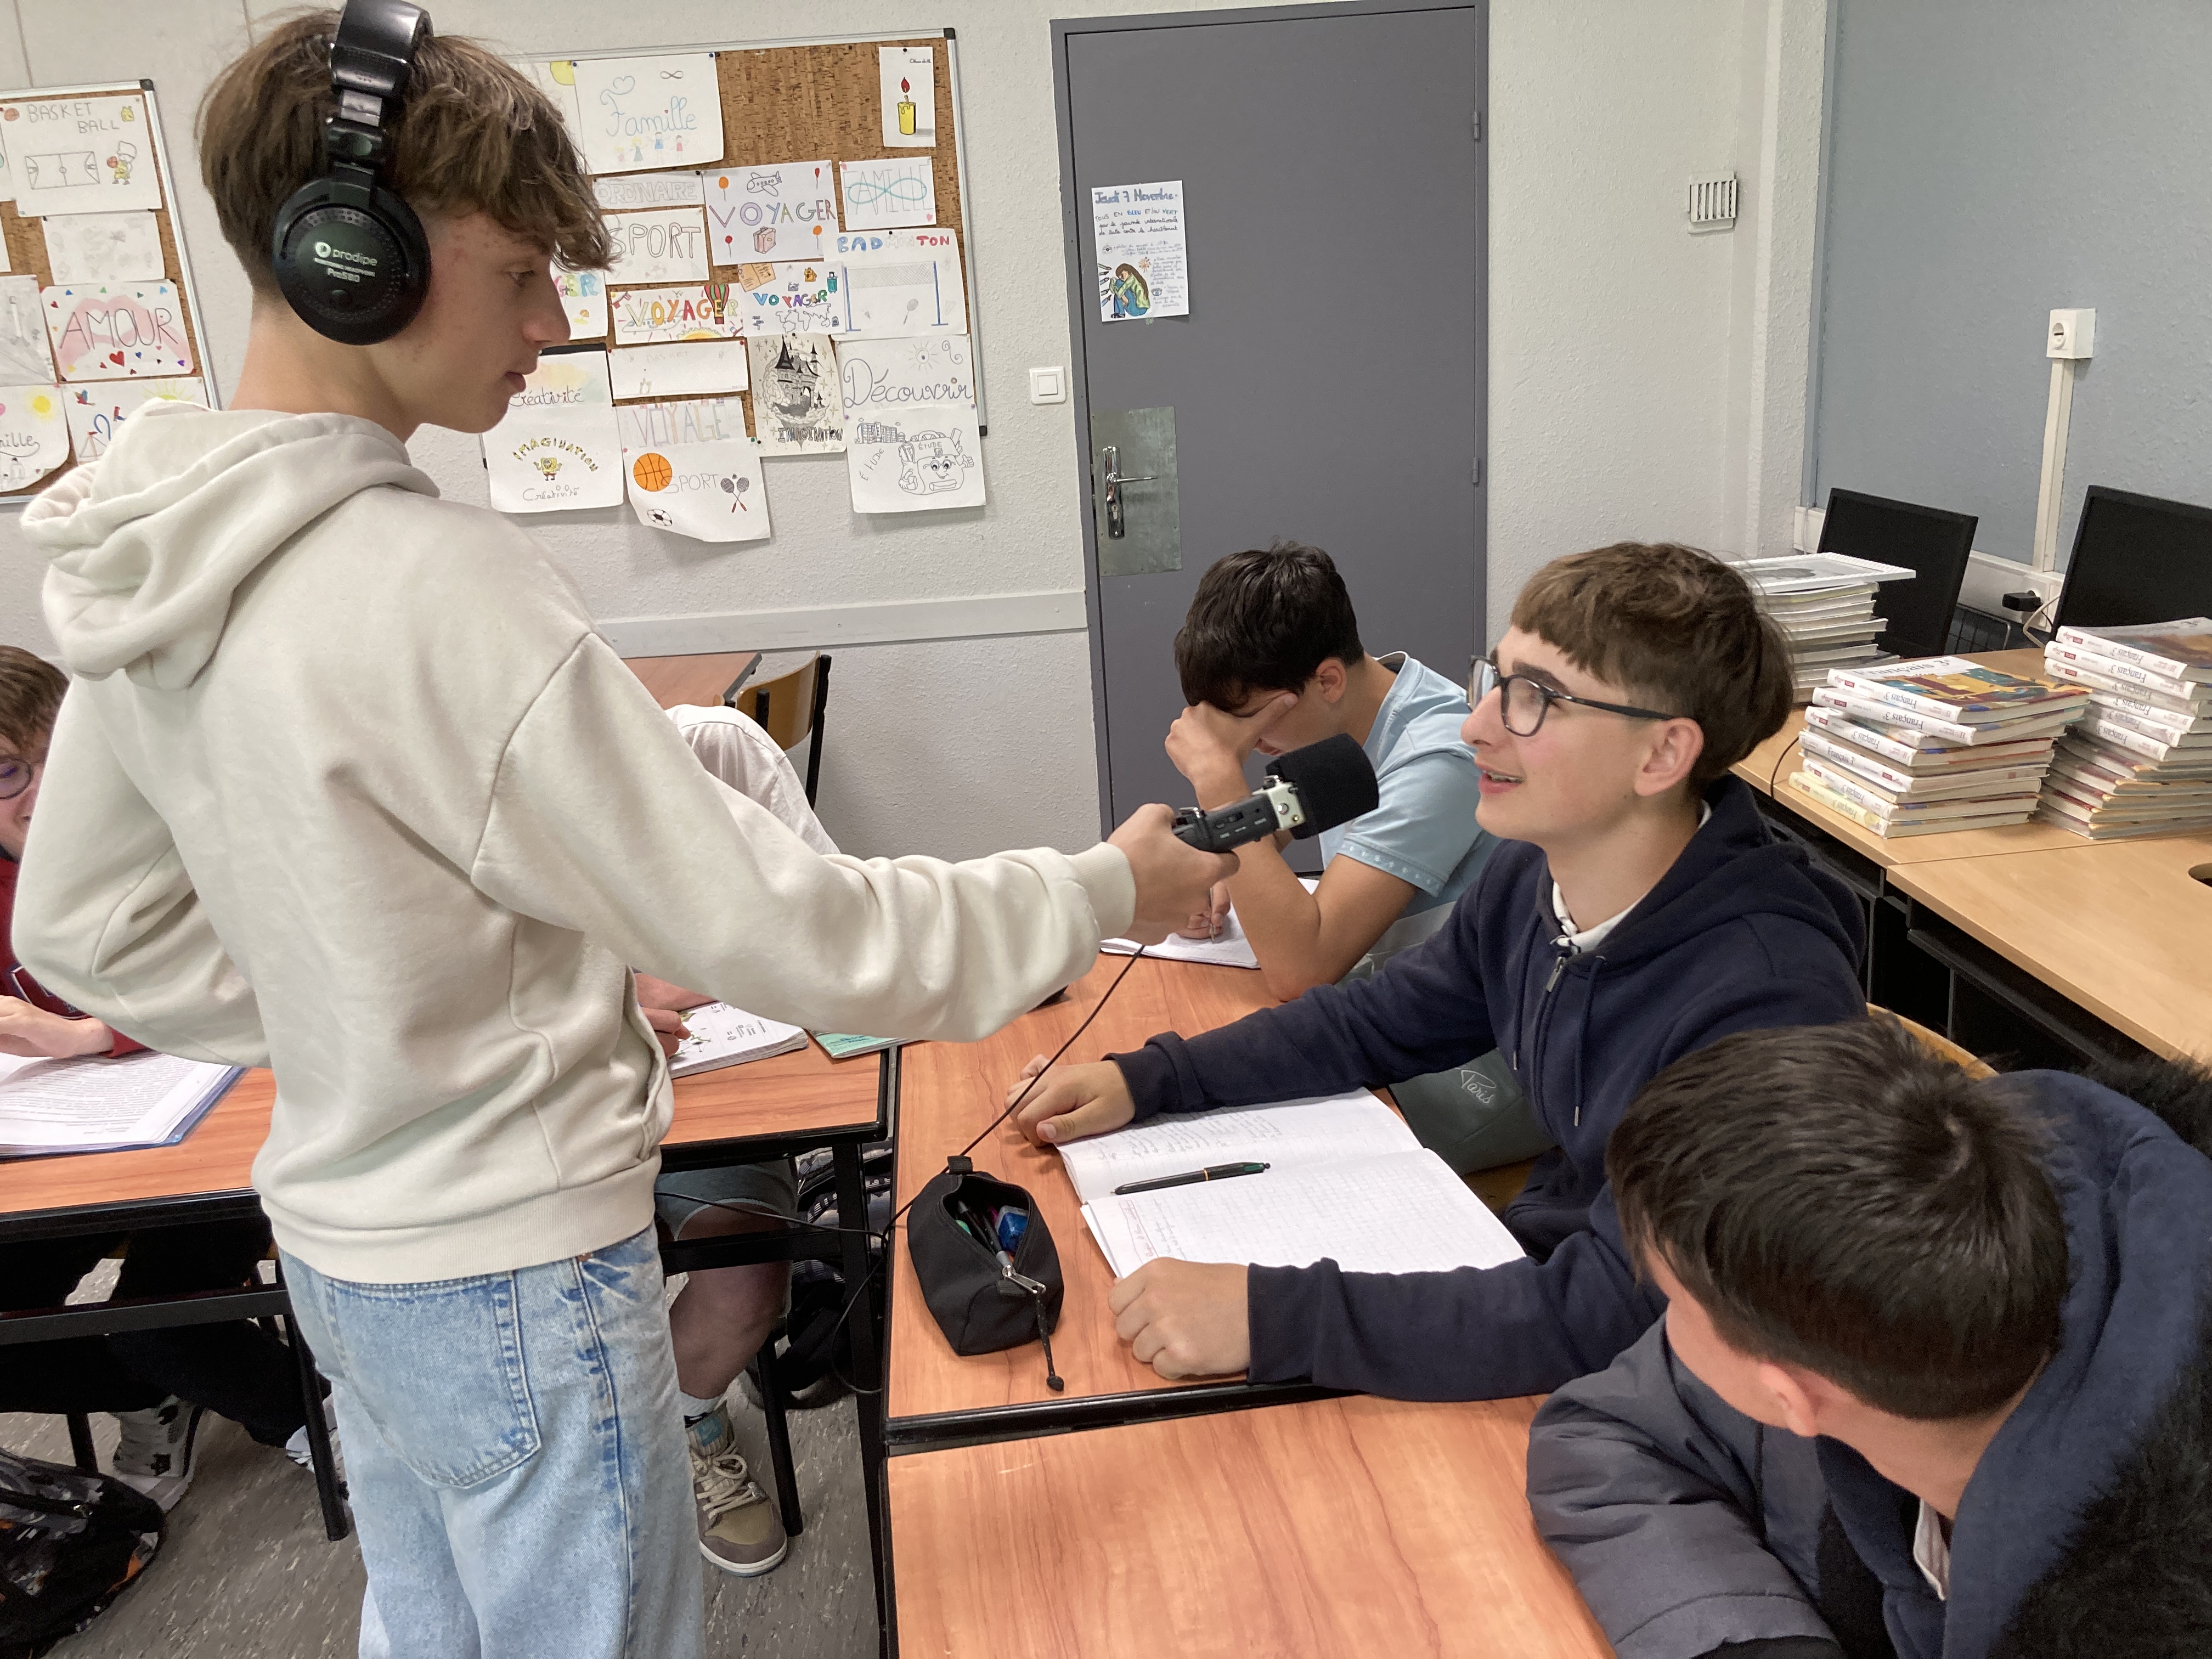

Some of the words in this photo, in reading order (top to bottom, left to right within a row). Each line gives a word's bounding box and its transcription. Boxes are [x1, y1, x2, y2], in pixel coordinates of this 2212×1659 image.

[27, 102, 92, 123] BASKET
[600, 83, 697, 137] Famille
[78, 119, 120, 133] BALL
[843, 164, 934, 215] FAMILLE
[1122, 190, 1130, 202] 7
[709, 200, 836, 228] VOYAGER
[625, 299, 738, 326] VOYAGER
[60, 307, 179, 351] AMOUR
[843, 358, 973, 408] Découvrir
[633, 399, 730, 448] VOYAGE
[777, 426, 843, 443] IMAGINATION
[512, 437, 599, 472] IMAGINATION
[918, 441, 943, 450] ÉTUDE
[661, 473, 719, 494] SPORT
[2118, 647, 2145, 664] Français
[1853, 662, 1931, 676] Français
[2117, 665, 2147, 684] Français
[1891, 691, 1917, 709] Français
[2121, 683, 2153, 701] Français
[2121, 698, 2152, 716] Français
[1892, 711, 1924, 730] Français
[2114, 713, 2142, 731] Français
[1858, 731, 1880, 750] Français
[2103, 726, 2128, 745] Français
[1827, 747, 1849, 763] Français
[1846, 786, 1865, 803] Français
[1837, 803, 1858, 820] Français
